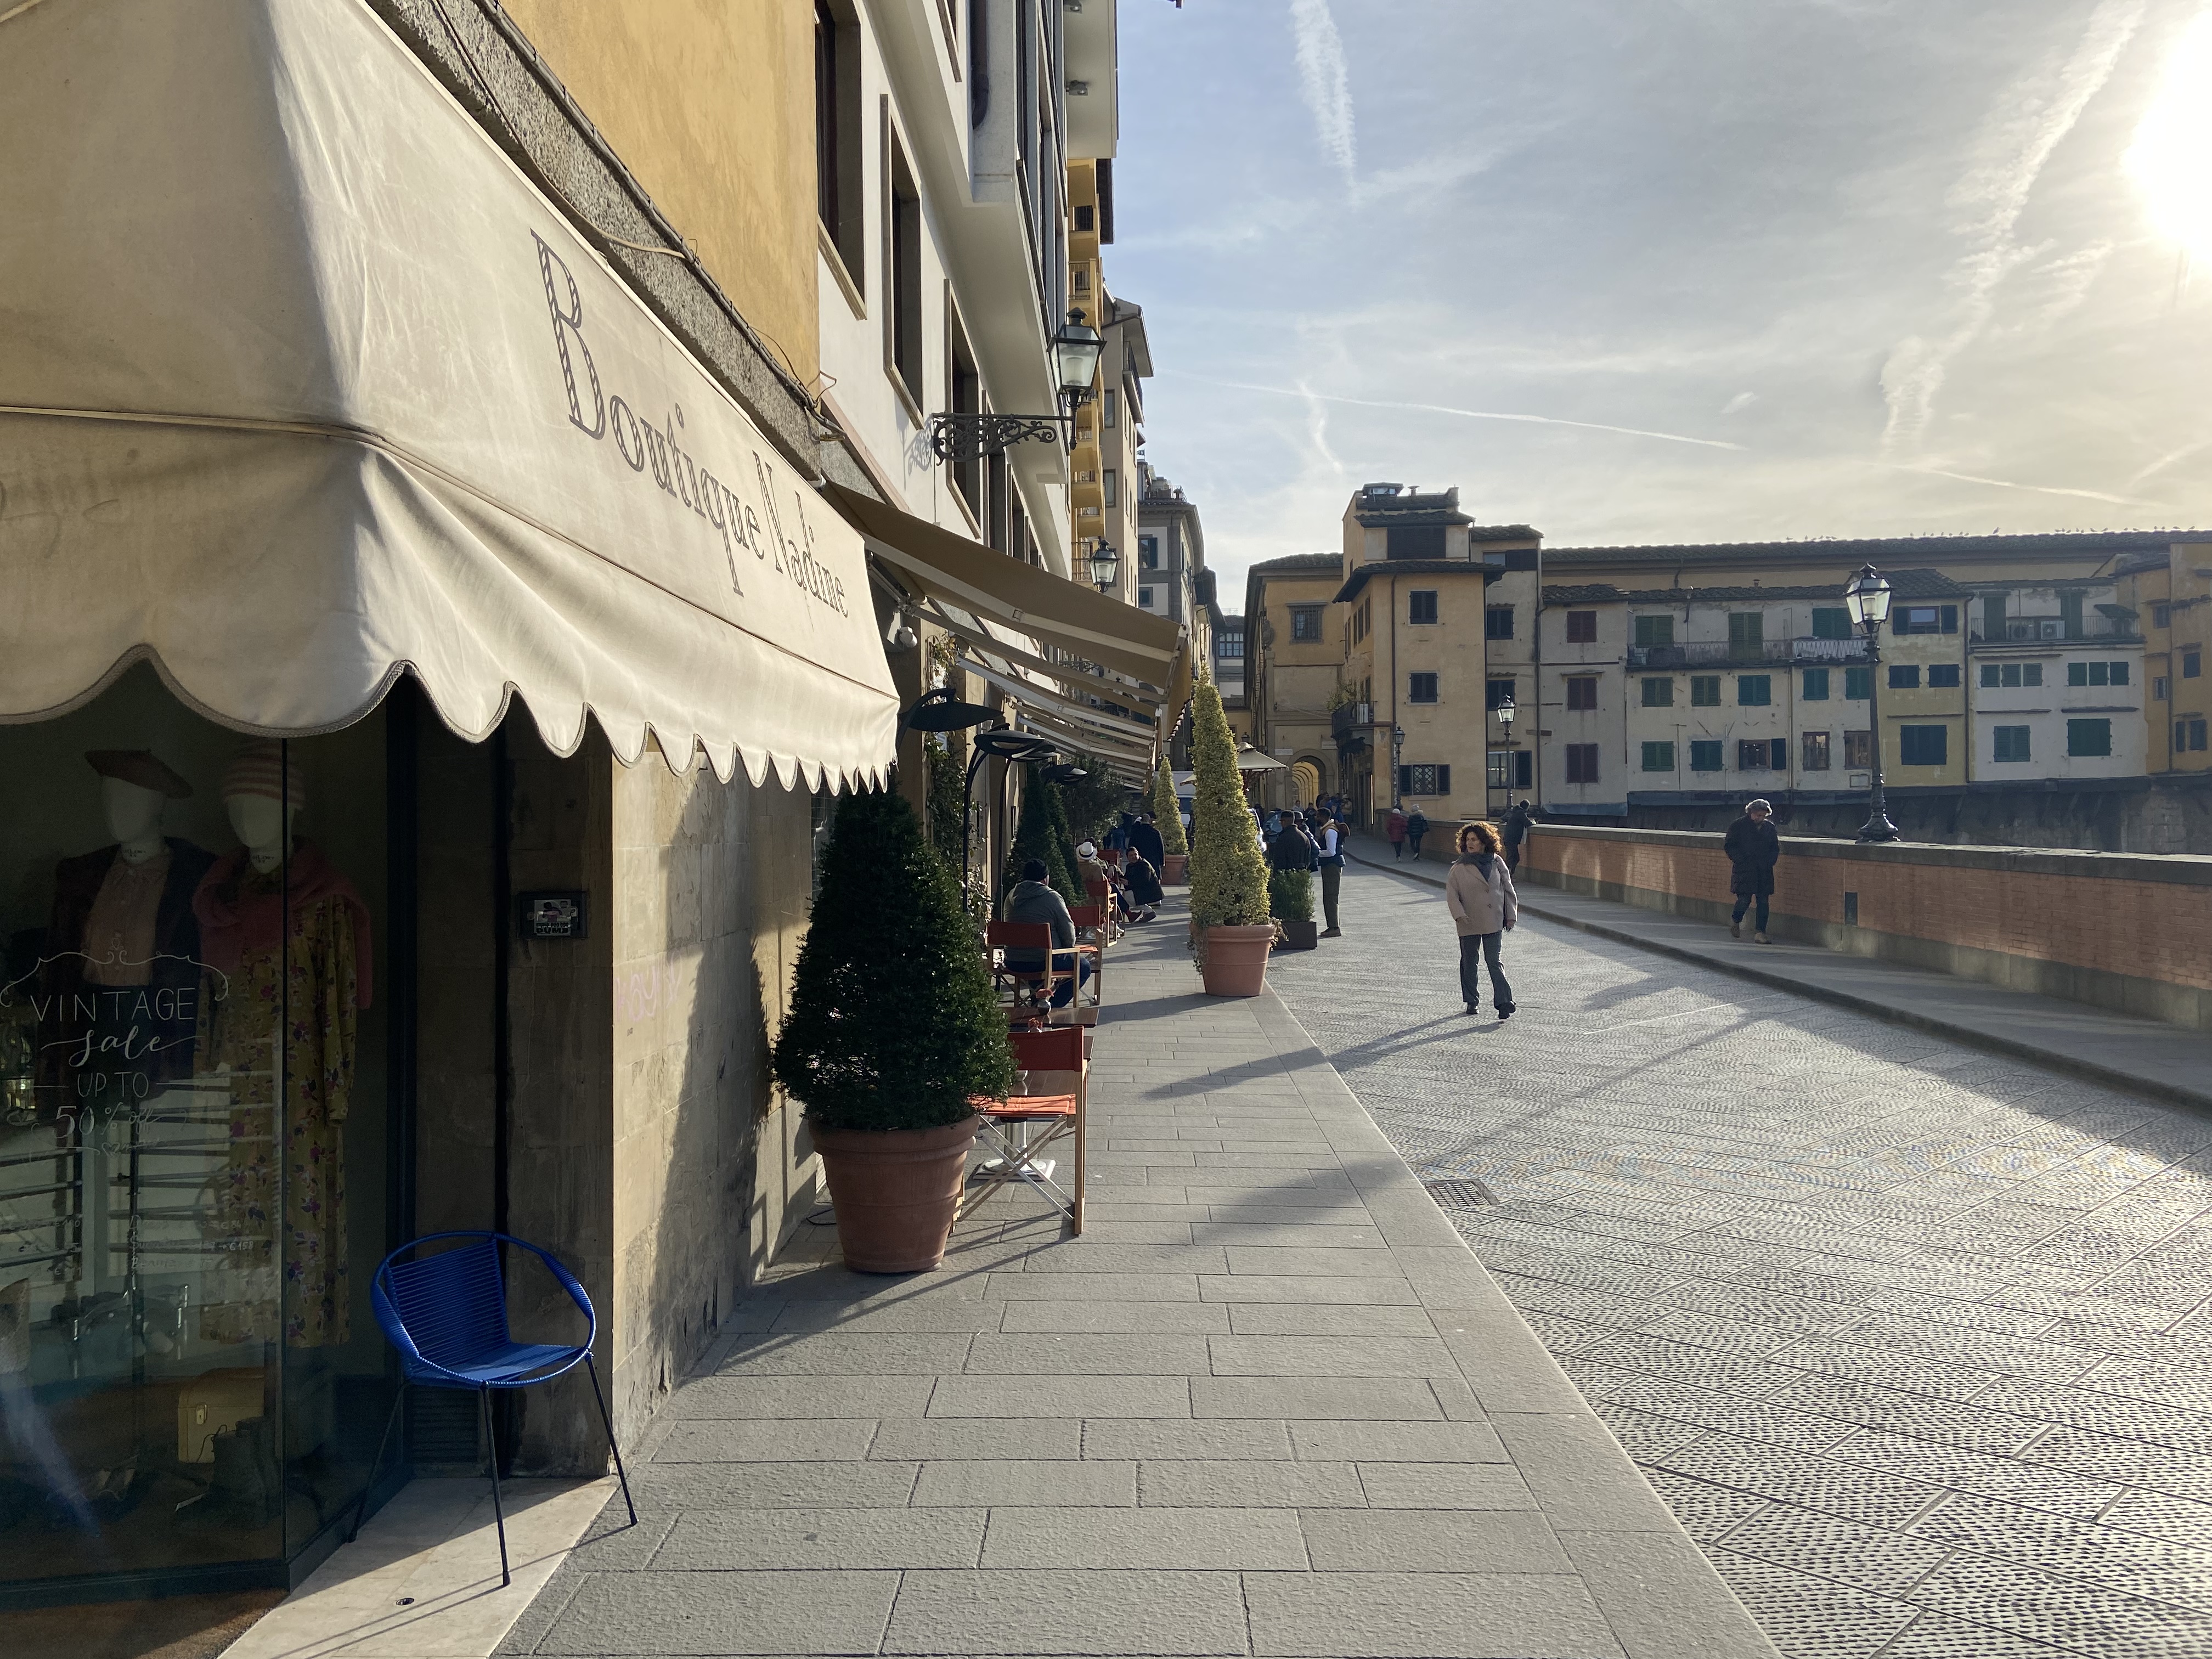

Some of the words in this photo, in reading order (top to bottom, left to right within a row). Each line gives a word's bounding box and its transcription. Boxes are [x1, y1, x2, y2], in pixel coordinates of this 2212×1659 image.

[531, 228, 765, 597] Boutique
[752, 449, 849, 618] Nadine
[30, 988, 196, 1022] VINTAGE
[77, 1073, 107, 1098] UP
[114, 1071, 150, 1098] TO
